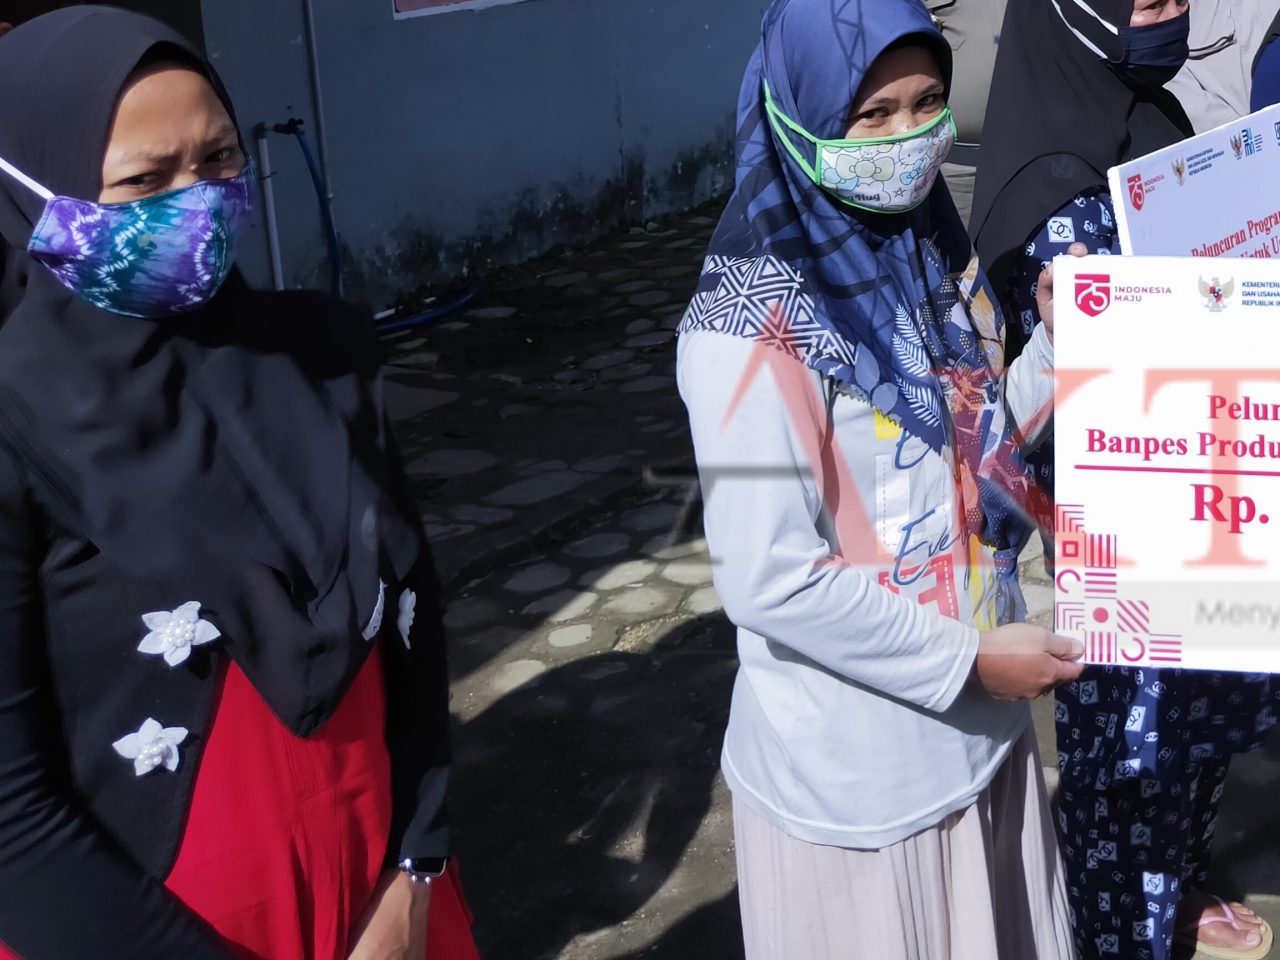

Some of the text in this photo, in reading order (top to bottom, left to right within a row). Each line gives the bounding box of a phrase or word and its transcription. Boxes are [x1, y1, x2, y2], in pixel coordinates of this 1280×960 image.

[1114, 286, 1172, 294] INDONESIA
[1085, 427, 1188, 462] Banpes
[1189, 483, 1270, 534] Rp.
